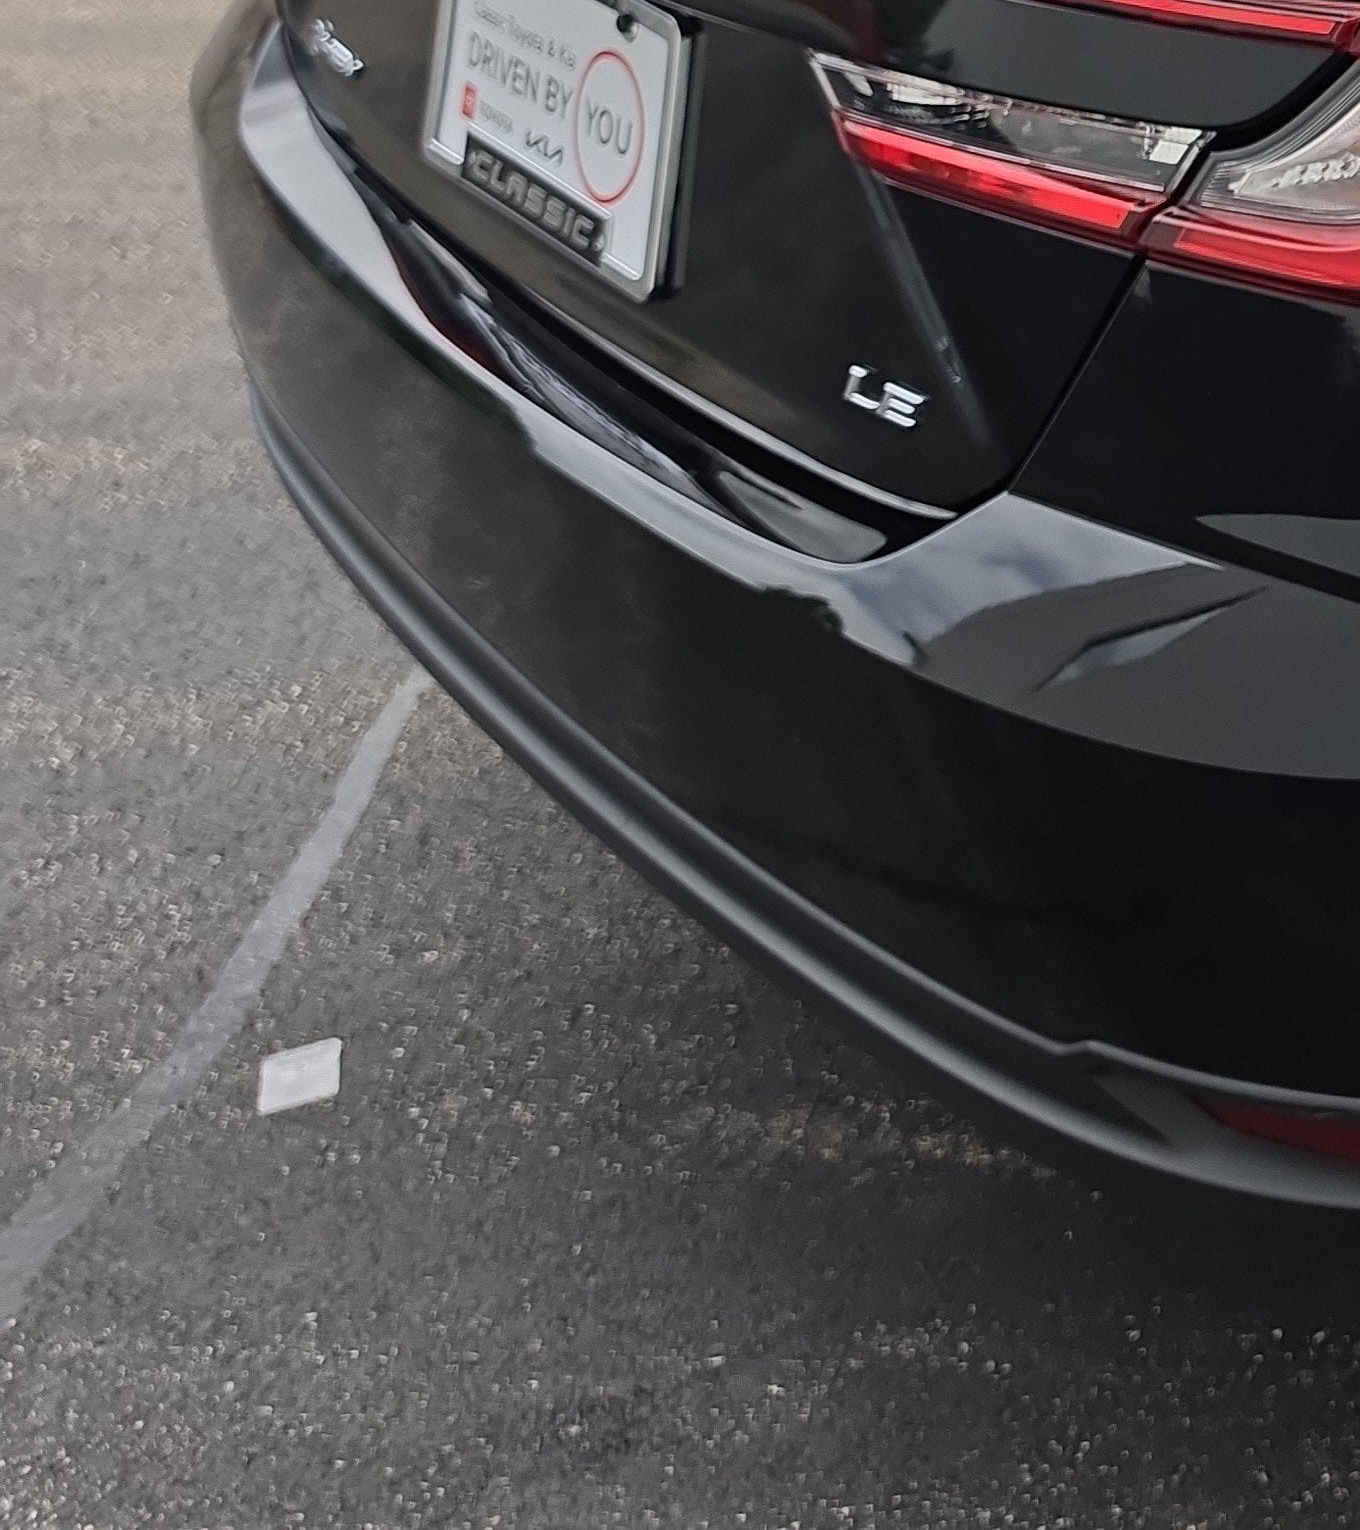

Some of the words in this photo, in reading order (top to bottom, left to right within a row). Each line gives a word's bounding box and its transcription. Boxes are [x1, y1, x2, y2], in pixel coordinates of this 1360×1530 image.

[468, 31, 540, 103] DRIVEN
[544, 78, 575, 119] BY
[585, 95, 634, 156] YOU
[472, 150, 596, 248] CLASSIC
[843, 364, 925, 427] LE
